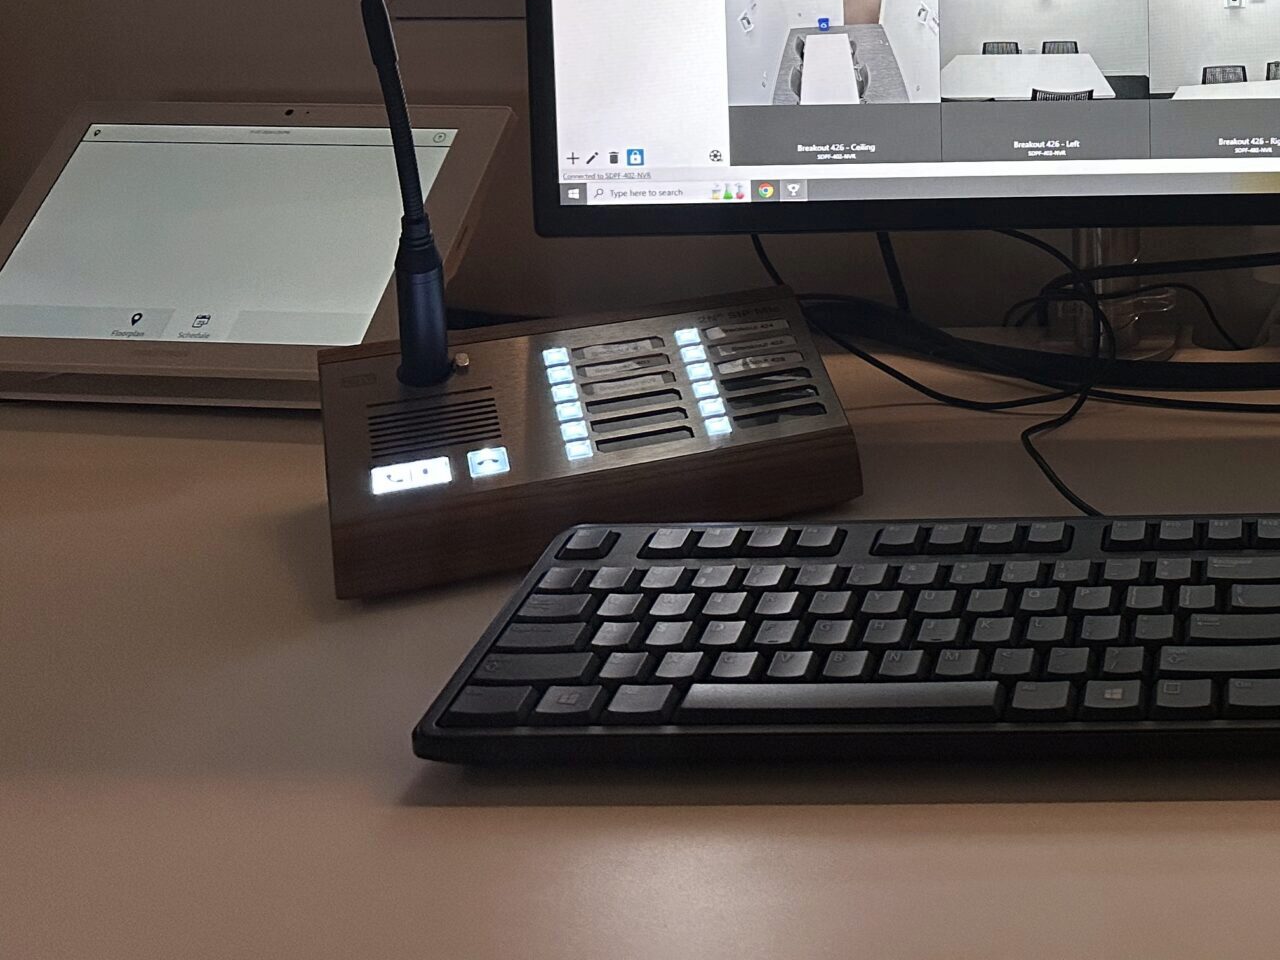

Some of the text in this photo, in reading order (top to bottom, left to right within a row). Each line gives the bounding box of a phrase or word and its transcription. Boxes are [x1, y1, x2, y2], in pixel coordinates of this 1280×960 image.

[1219, 138, 1249, 147] Breakout
[1251, 138, 1264, 146] 426
[798, 144, 829, 152] Breakout
[851, 144, 875, 152] Ceiling
[610, 190, 628, 198] Type
[630, 189, 646, 197] here
[111, 329, 144, 338] Floorplan
[177, 331, 210, 339] Schedule
